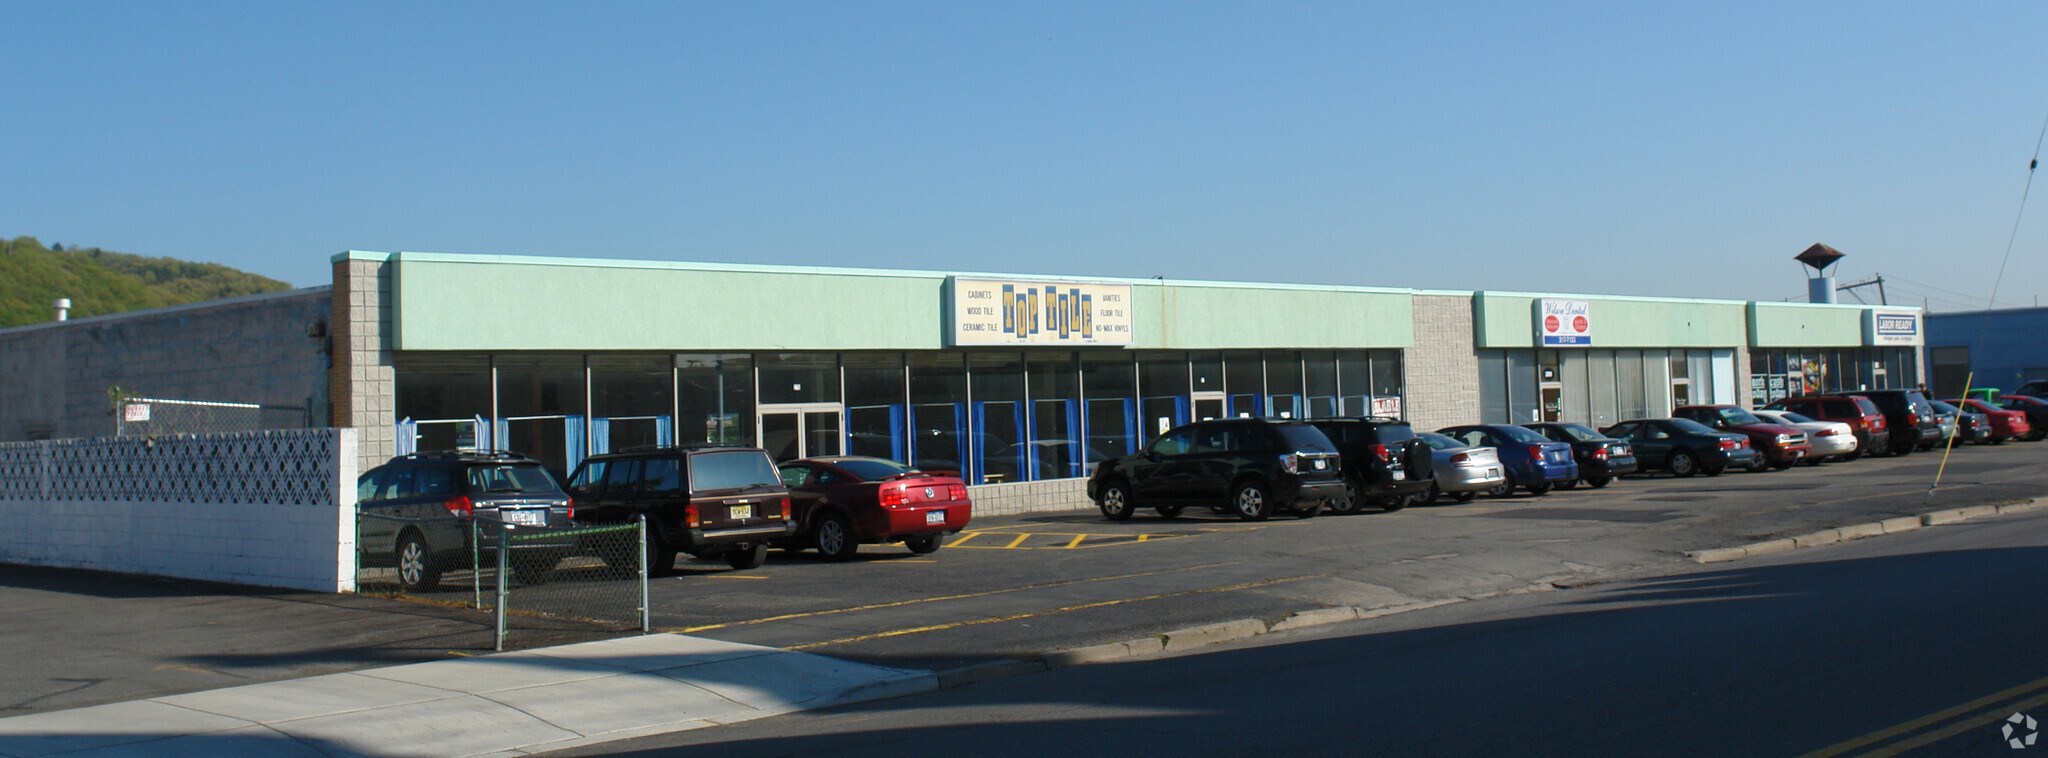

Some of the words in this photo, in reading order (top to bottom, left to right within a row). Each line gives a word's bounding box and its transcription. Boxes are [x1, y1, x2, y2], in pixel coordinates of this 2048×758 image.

[967, 290, 992, 299] CABINETS
[1102, 294, 1121, 302] VANITIES
[967, 307, 982, 315] WOOD
[983, 307, 994, 315] TILE
[1100, 309, 1113, 317] FLOOR
[1114, 309, 1123, 317] TILE
[1545, 302, 1565, 315] Wilson
[1565, 302, 1588, 315] Dental
[1003, 290, 1037, 337] TOP
[1046, 292, 1091, 336] TILE
[962, 323, 985, 331] CERAMIC
[987, 323, 998, 332] TILE
[1879, 319, 1895, 330] LABOR
[1895, 319, 1913, 330] READY
